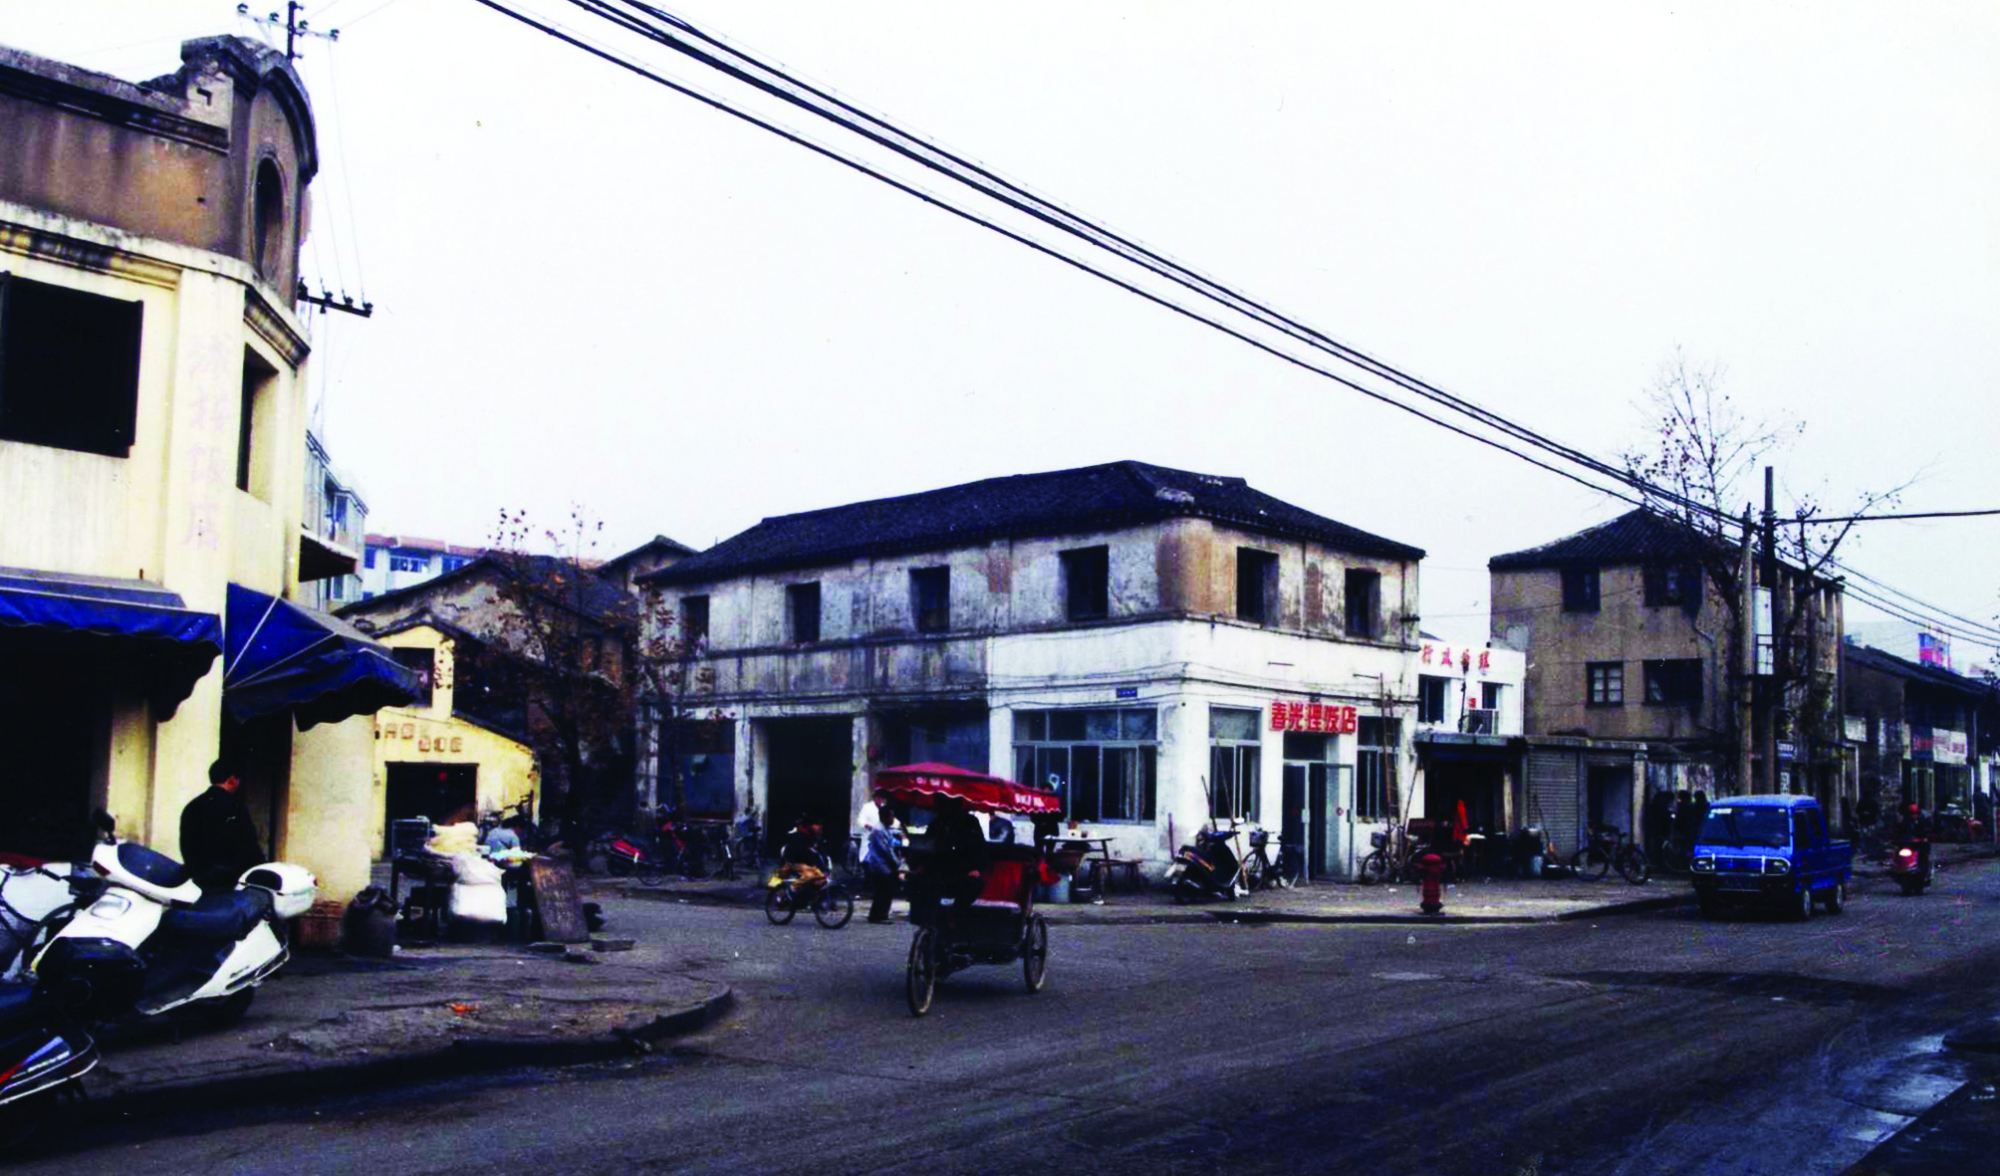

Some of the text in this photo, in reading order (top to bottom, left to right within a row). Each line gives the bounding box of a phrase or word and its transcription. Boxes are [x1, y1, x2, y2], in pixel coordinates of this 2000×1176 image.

[1272, 702, 1356, 732] 春光理发店
